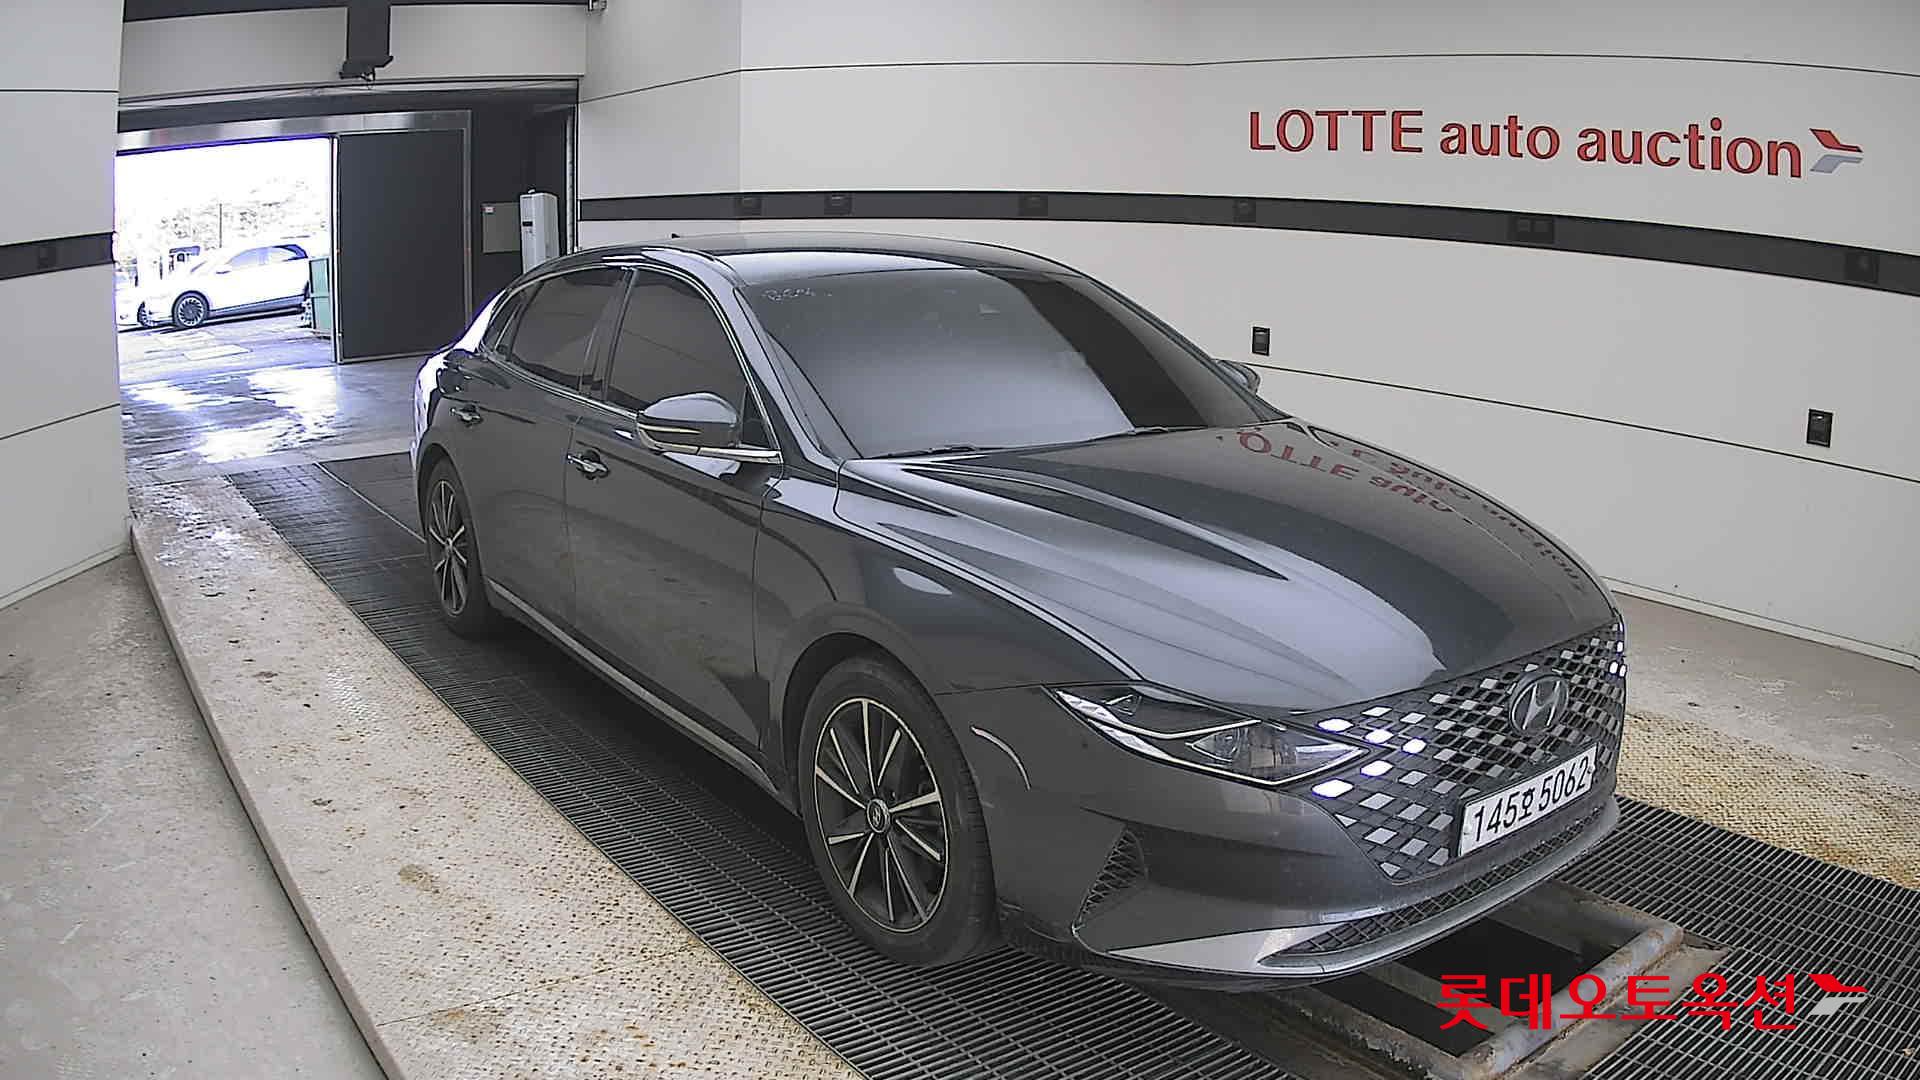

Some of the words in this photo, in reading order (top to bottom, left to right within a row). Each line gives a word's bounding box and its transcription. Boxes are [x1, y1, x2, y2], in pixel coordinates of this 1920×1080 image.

[1248, 109, 1424, 154] LOTTE
[1440, 114, 1562, 160] auto
[1576, 117, 1802, 179] auction
